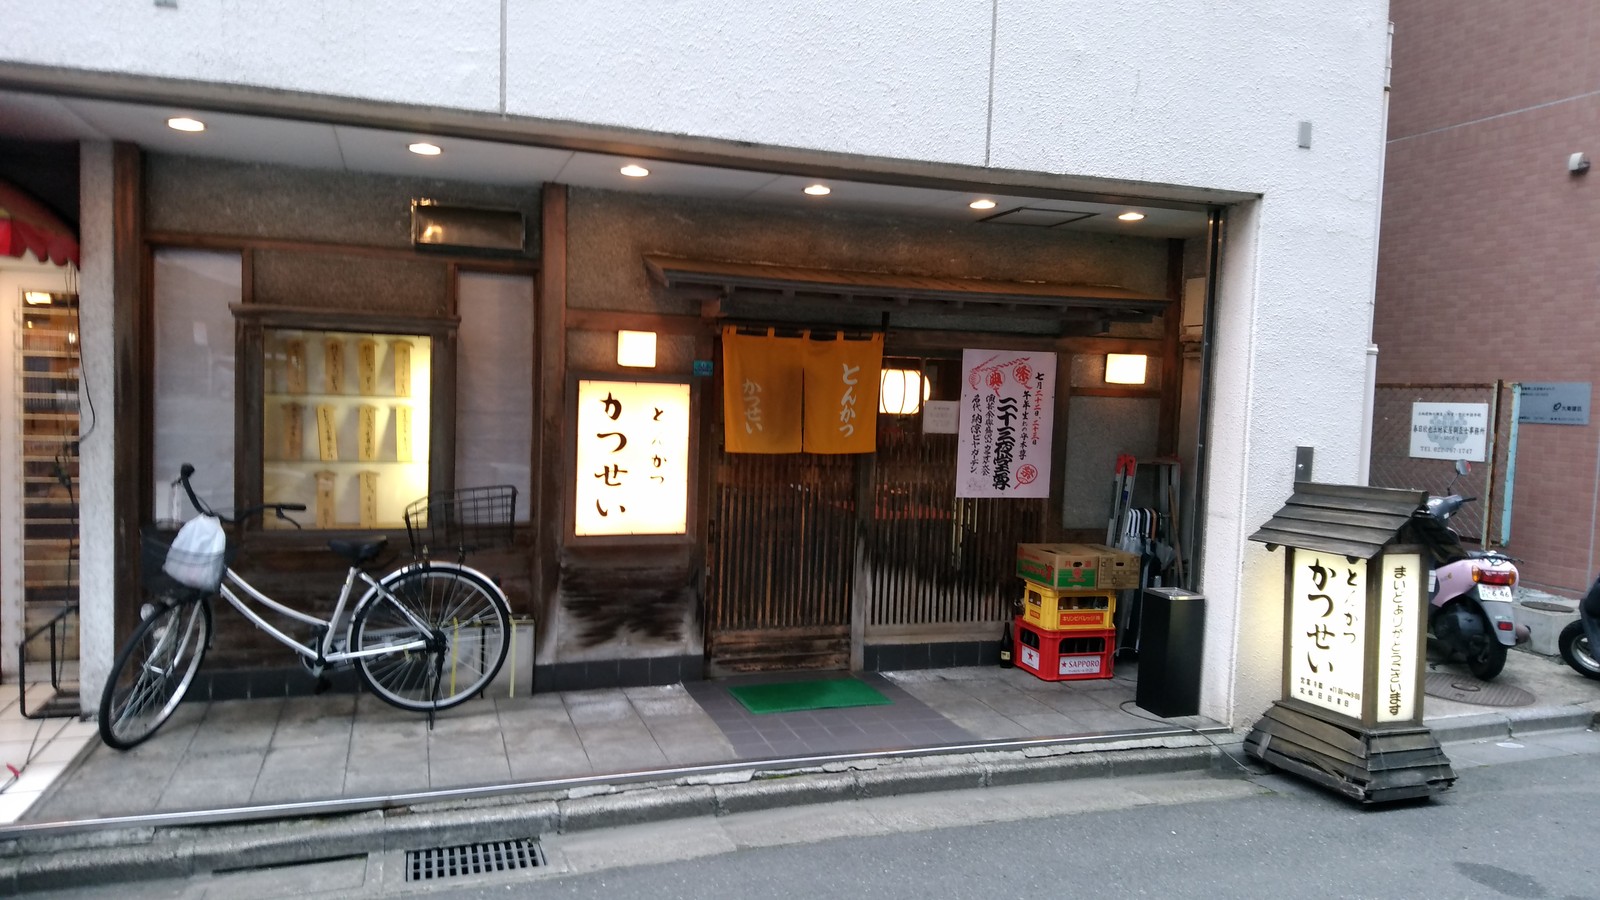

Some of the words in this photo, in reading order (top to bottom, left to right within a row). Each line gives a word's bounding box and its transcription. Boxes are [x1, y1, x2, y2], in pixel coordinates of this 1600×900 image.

[742, 377, 764, 434] かつせい
[839, 363, 861, 438] とんかつ
[594, 391, 628, 517] かつせい
[650, 407, 667, 484] とかつ
[1307, 558, 1337, 673] かつせい
[1068, 660, 1100, 668] SAPPORO
